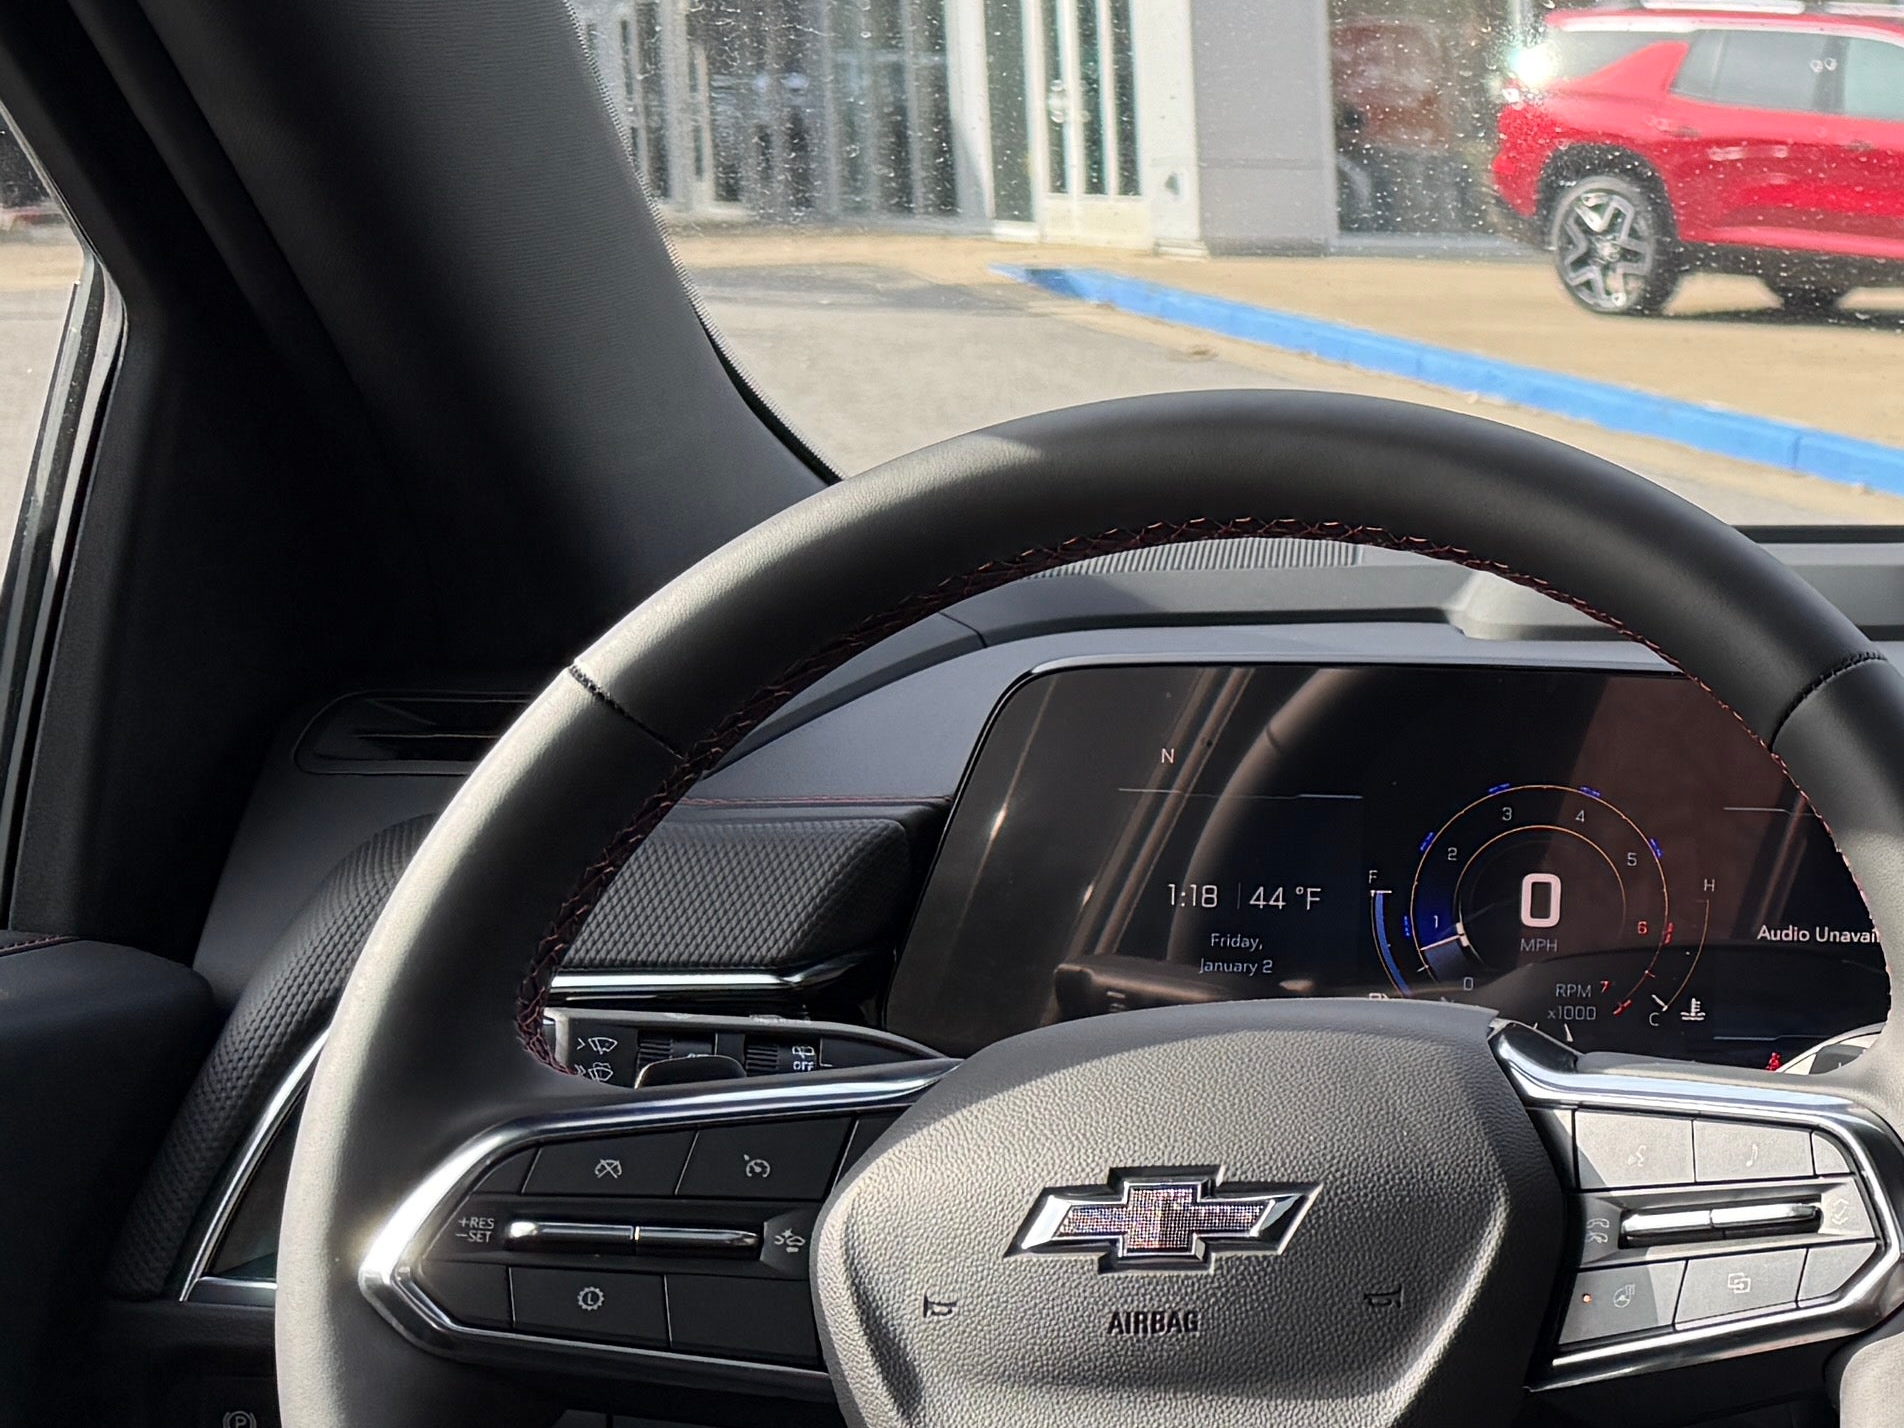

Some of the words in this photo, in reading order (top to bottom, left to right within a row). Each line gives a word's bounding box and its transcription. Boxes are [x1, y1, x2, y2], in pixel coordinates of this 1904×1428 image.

[1160, 747, 1175, 764] N
[1501, 806, 1513, 822] 3
[1575, 809, 1586, 823] 4
[1447, 847, 1458, 862] 2
[1626, 852, 1638, 867] 5
[1368, 869, 1379, 884] F
[1703, 878, 1716, 893] H
[1167, 883, 1218, 909] 1:18
[1249, 885, 1287, 910] 44
[1520, 872, 1562, 928] 0
[1433, 915, 1440, 929] 1
[1637, 920, 1648, 935] 6
[1756, 924, 1811, 943] Audio
[1210, 932, 1264, 951] Friday,
[1519, 938, 1558, 953] MPH
[1198, 957, 1258, 977] January
[1262, 959, 1274, 974] 2
[1462, 976, 1474, 991] 0
[1554, 983, 1592, 998] RPM
[1599, 980, 1611, 993] 7
[1546, 1005, 1598, 1022] x1000
[1648, 1012, 1660, 1028] C
[1106, 1310, 1200, 1336] AIRBAG
